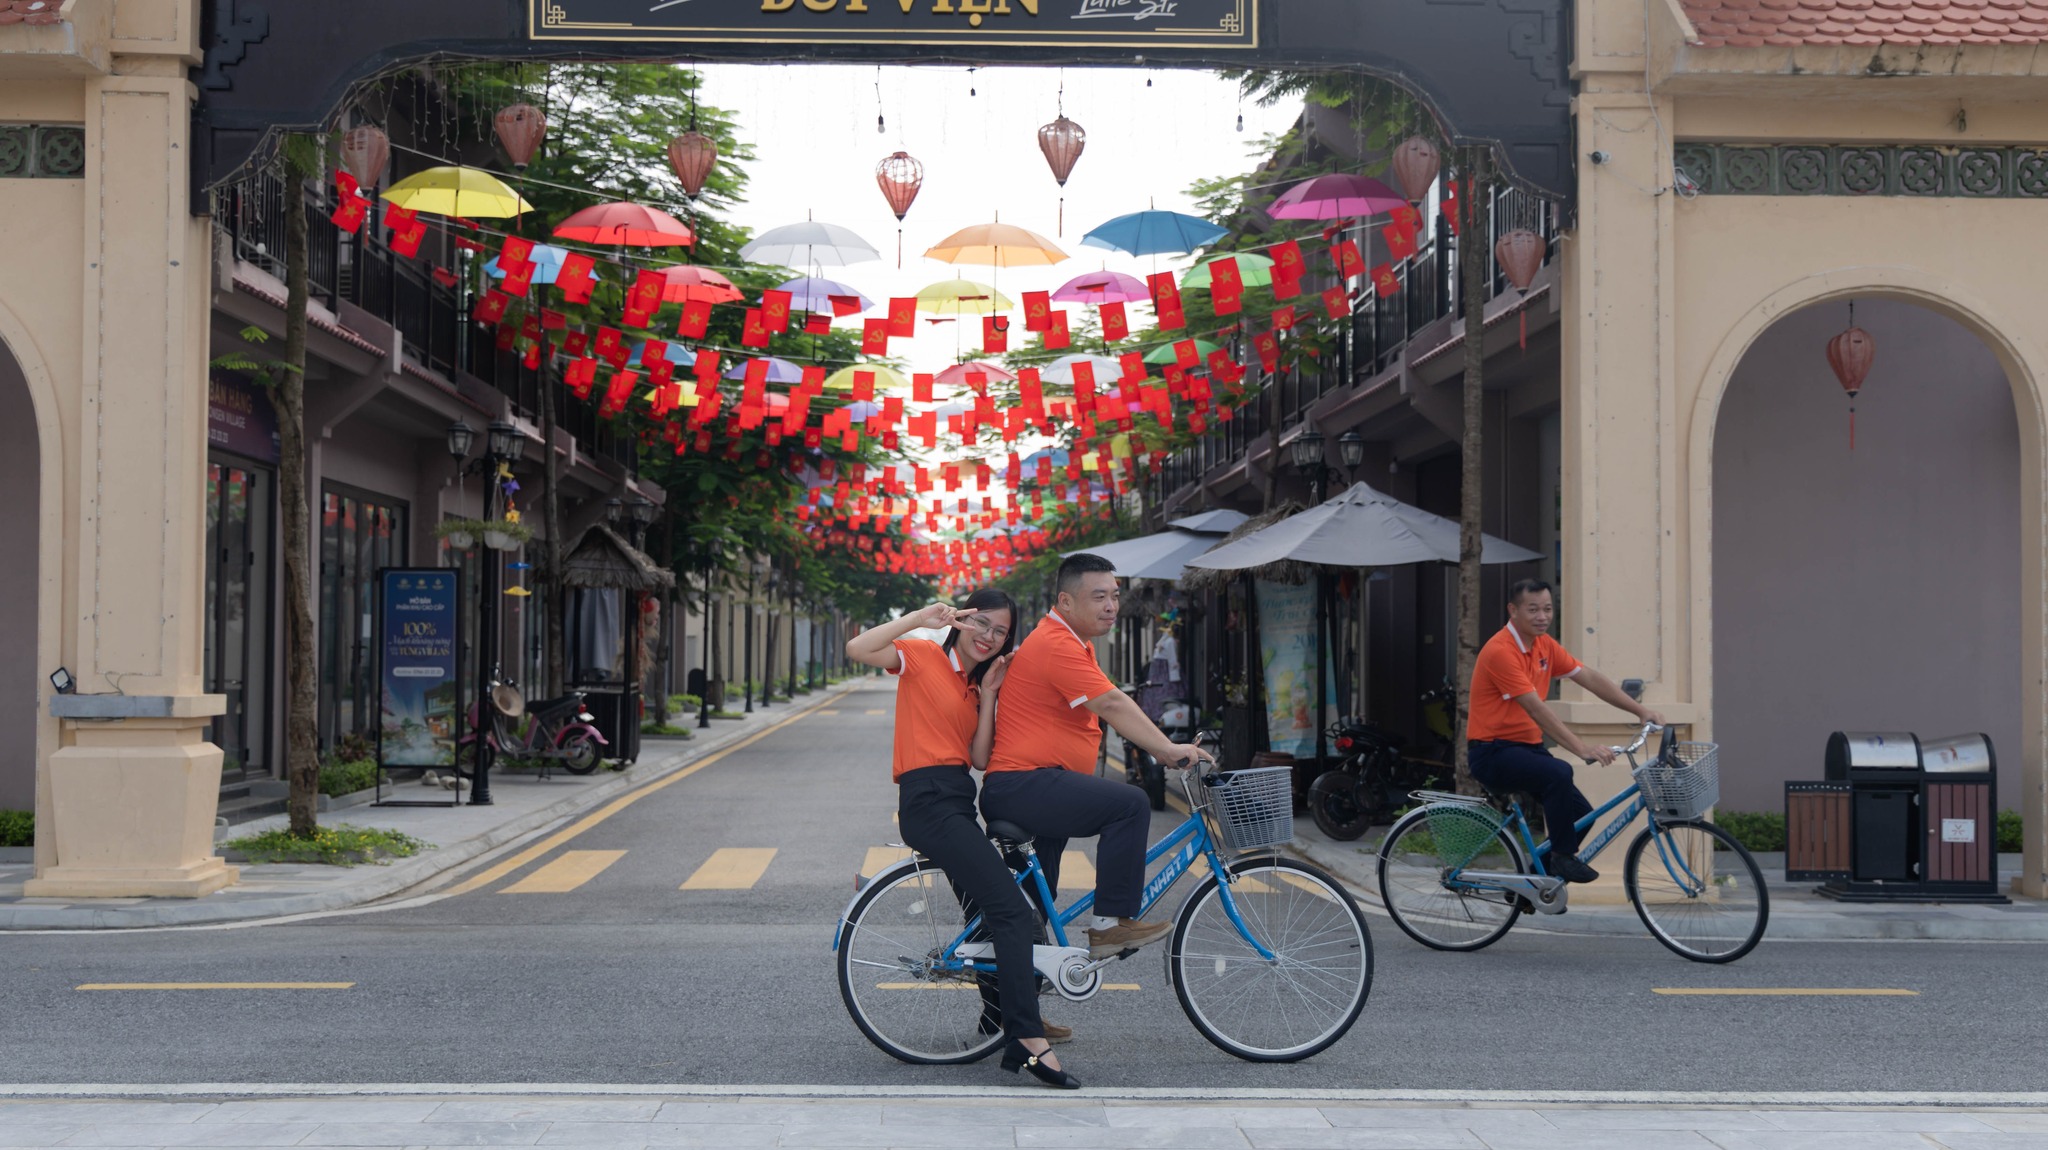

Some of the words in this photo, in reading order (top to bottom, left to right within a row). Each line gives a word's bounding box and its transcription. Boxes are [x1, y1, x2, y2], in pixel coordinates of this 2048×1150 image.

[404, 622, 437, 636] 100%
[1606, 810, 1631, 837] NHAT
[1149, 854, 1181, 899] NHAT
